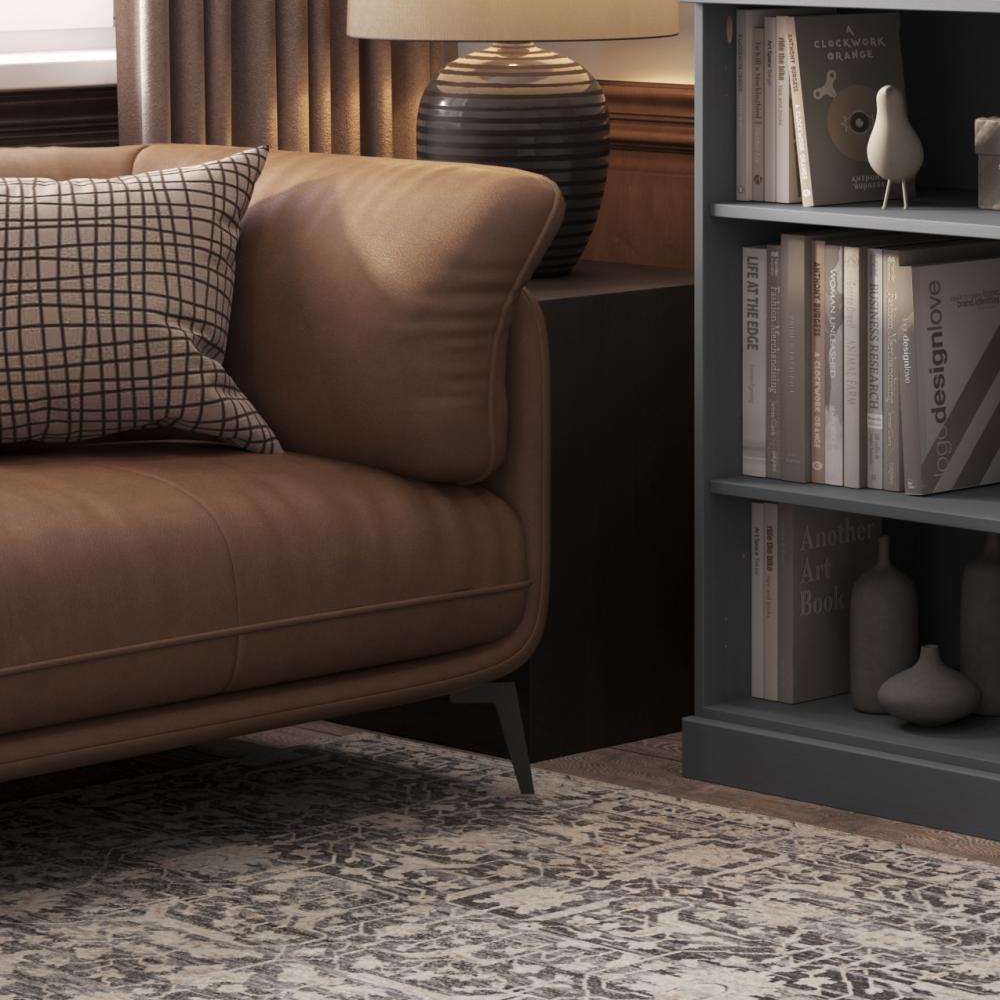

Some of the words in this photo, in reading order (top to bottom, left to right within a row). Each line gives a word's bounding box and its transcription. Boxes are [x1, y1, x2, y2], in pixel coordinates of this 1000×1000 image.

[813, 37, 886, 49] CLOCKWORK
[845, 25, 855, 36] A
[827, 49, 874, 62] ORANGE
[747, 256, 759, 279] LIFE
[747, 281, 759, 295] AT
[829, 270, 837, 314] WOMAN
[747, 297, 759, 318] THE
[869, 284, 879, 342] BUSINESS
[746, 321, 759, 350] EDGE
[869, 345, 879, 409] RESEARCH
[927, 279, 953, 476] logodesignlove
[800, 518, 875, 551] Another
[800, 556, 831, 584] Art
[800, 584, 845, 617] Book
